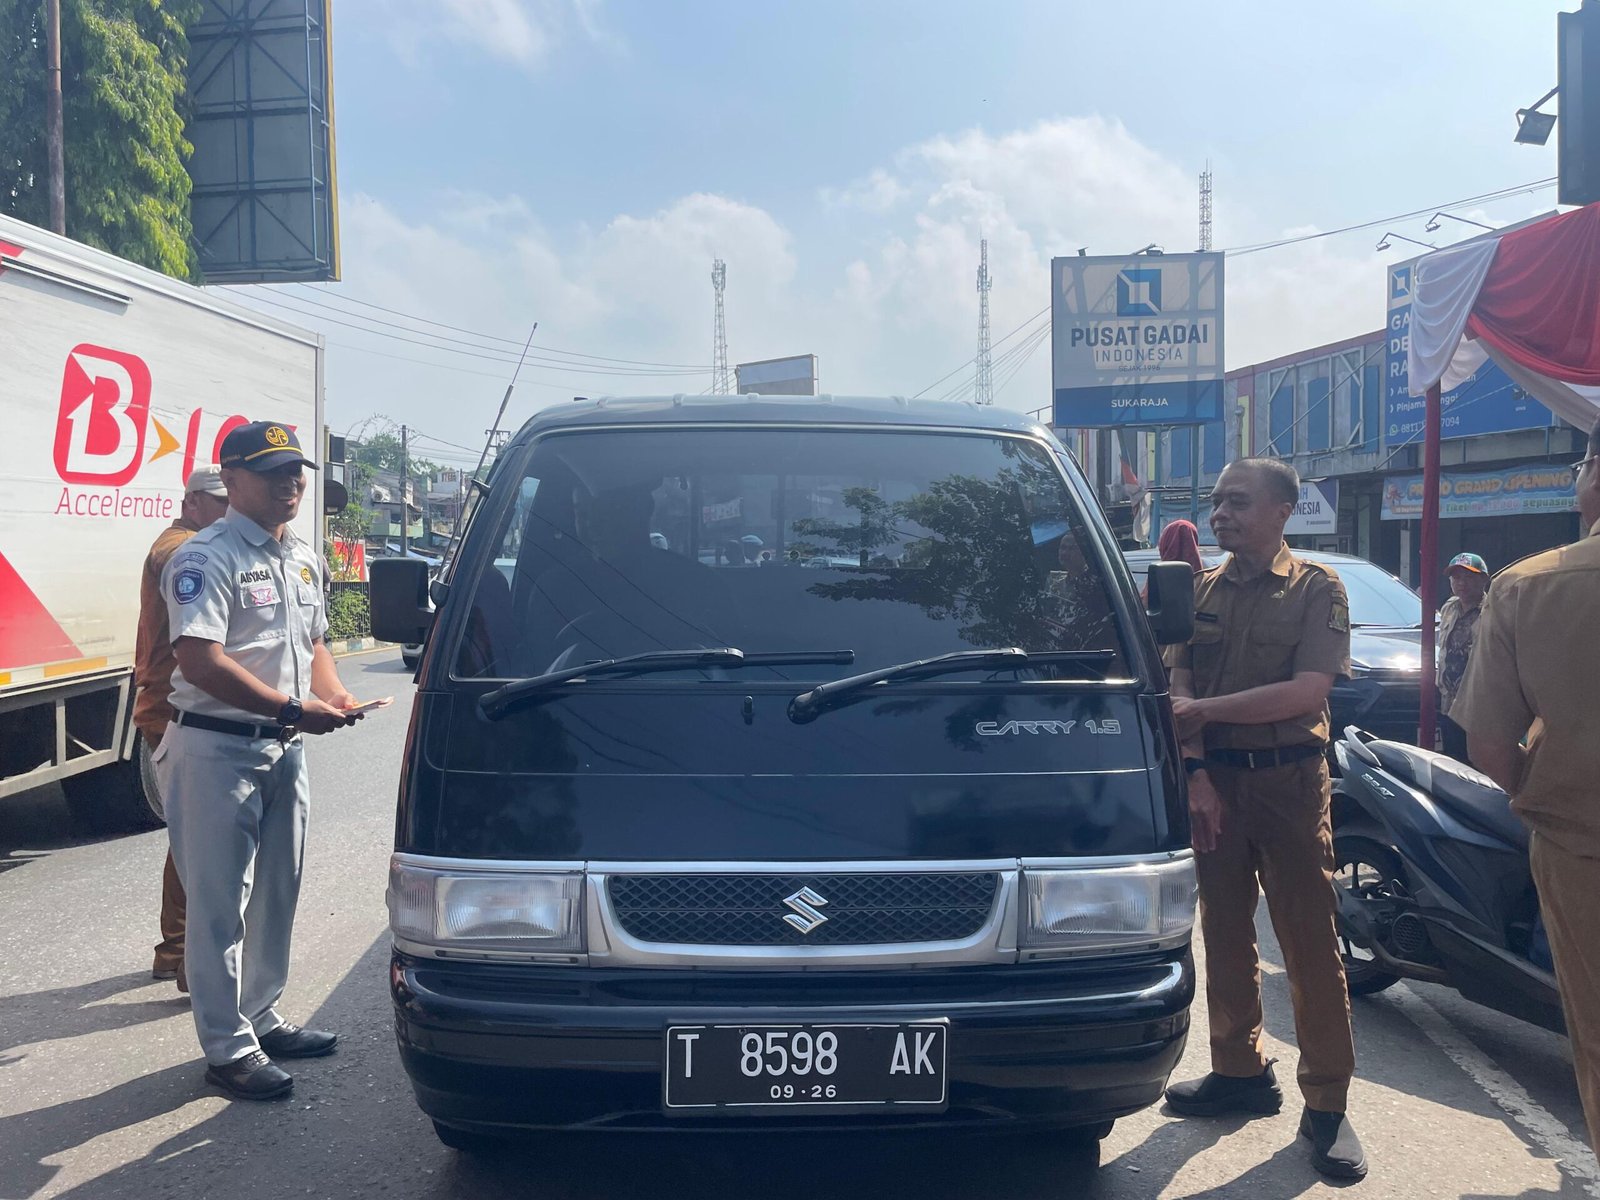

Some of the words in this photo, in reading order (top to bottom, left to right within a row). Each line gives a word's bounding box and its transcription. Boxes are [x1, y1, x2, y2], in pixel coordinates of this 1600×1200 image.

[1071, 327, 1139, 347] PUSAT
[1144, 324, 1208, 345] GADAI
[1095, 348, 1183, 363] INDONESIA
[1111, 398, 1169, 408] SUKARAJA
[1396, 400, 1426, 412] Pinjama
[1455, 479, 1503, 495] GRAND
[54, 487, 173, 519] Accelerate
[976, 720, 1077, 735] CARRY
[1084, 719, 1121, 734] 1.5
[677, 1033, 700, 1078] T
[740, 1031, 838, 1077] 8598
[889, 1032, 936, 1075] AK
